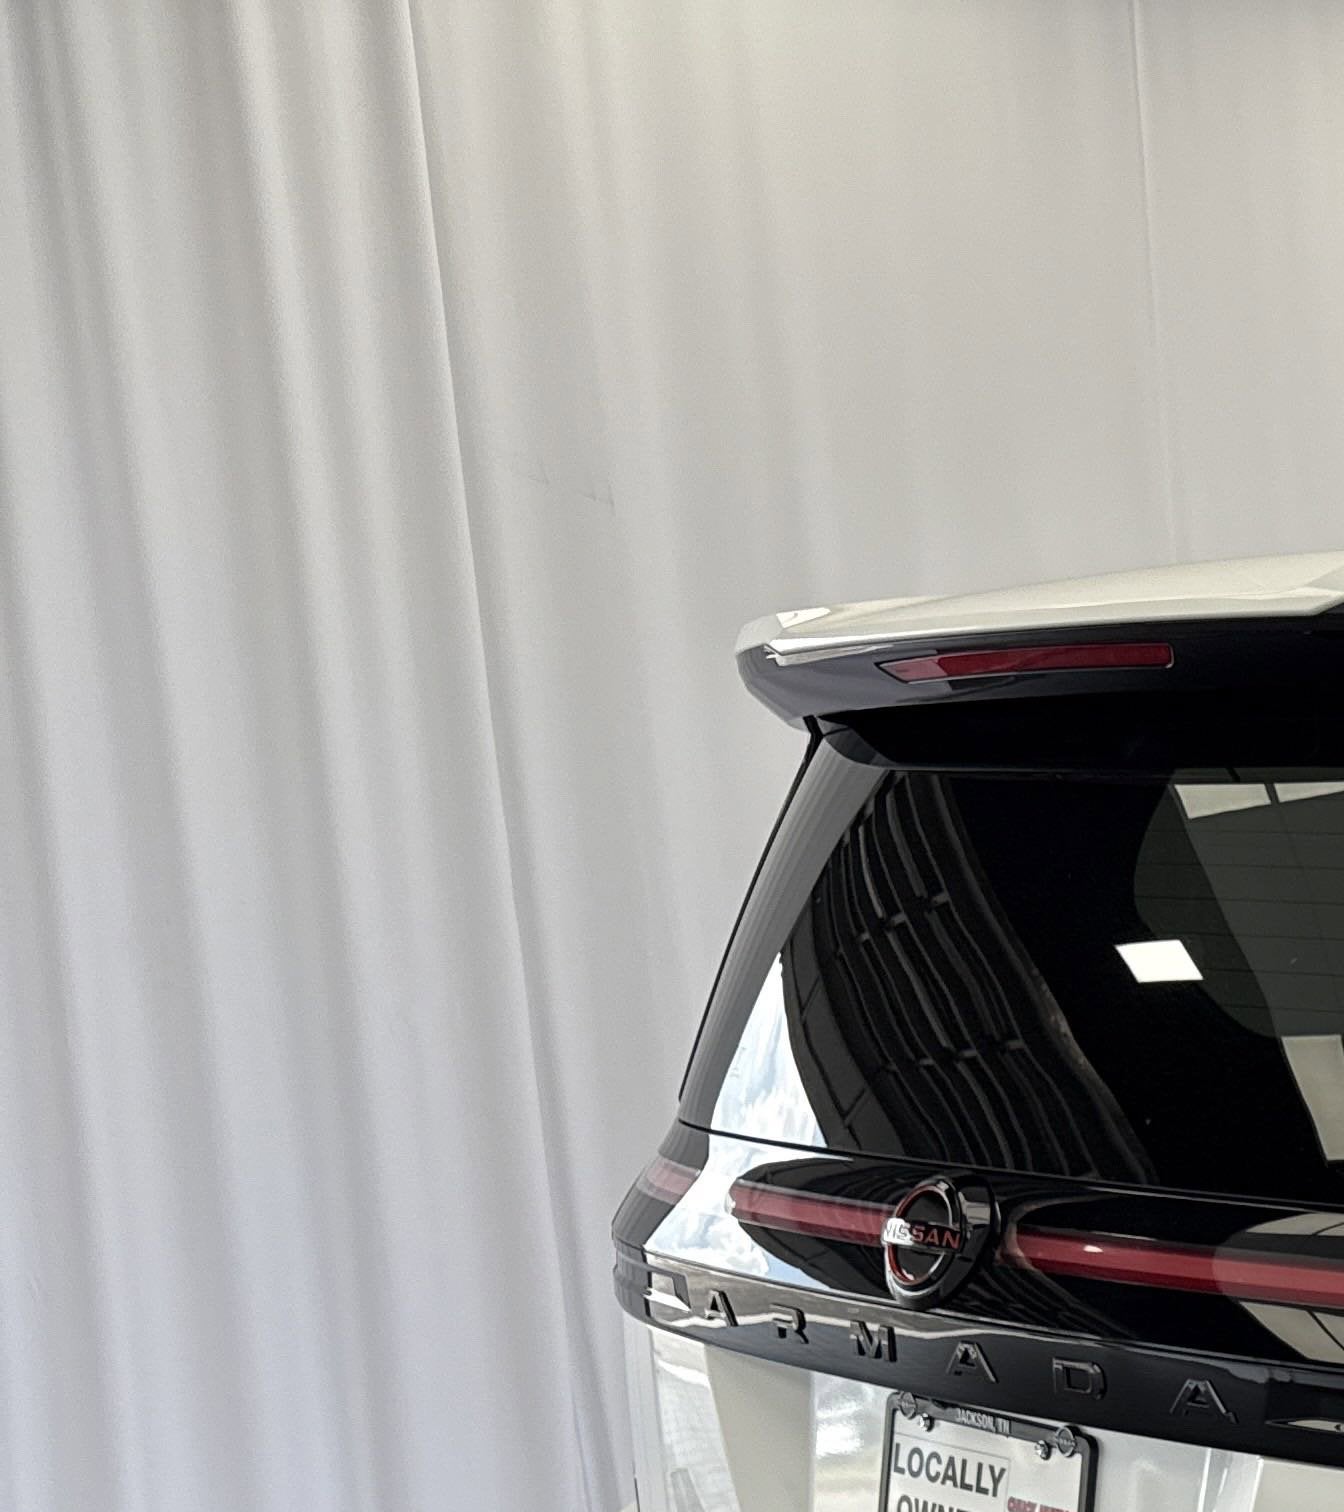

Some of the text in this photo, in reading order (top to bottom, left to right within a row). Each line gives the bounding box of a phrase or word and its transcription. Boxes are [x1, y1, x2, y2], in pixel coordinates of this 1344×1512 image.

[884, 1220, 961, 1249] NISSAN
[704, 1288, 1240, 1424] ARMADA
[956, 1408, 1011, 1434] JACKSON, TN
[893, 1442, 1006, 1497] LOCALLY
